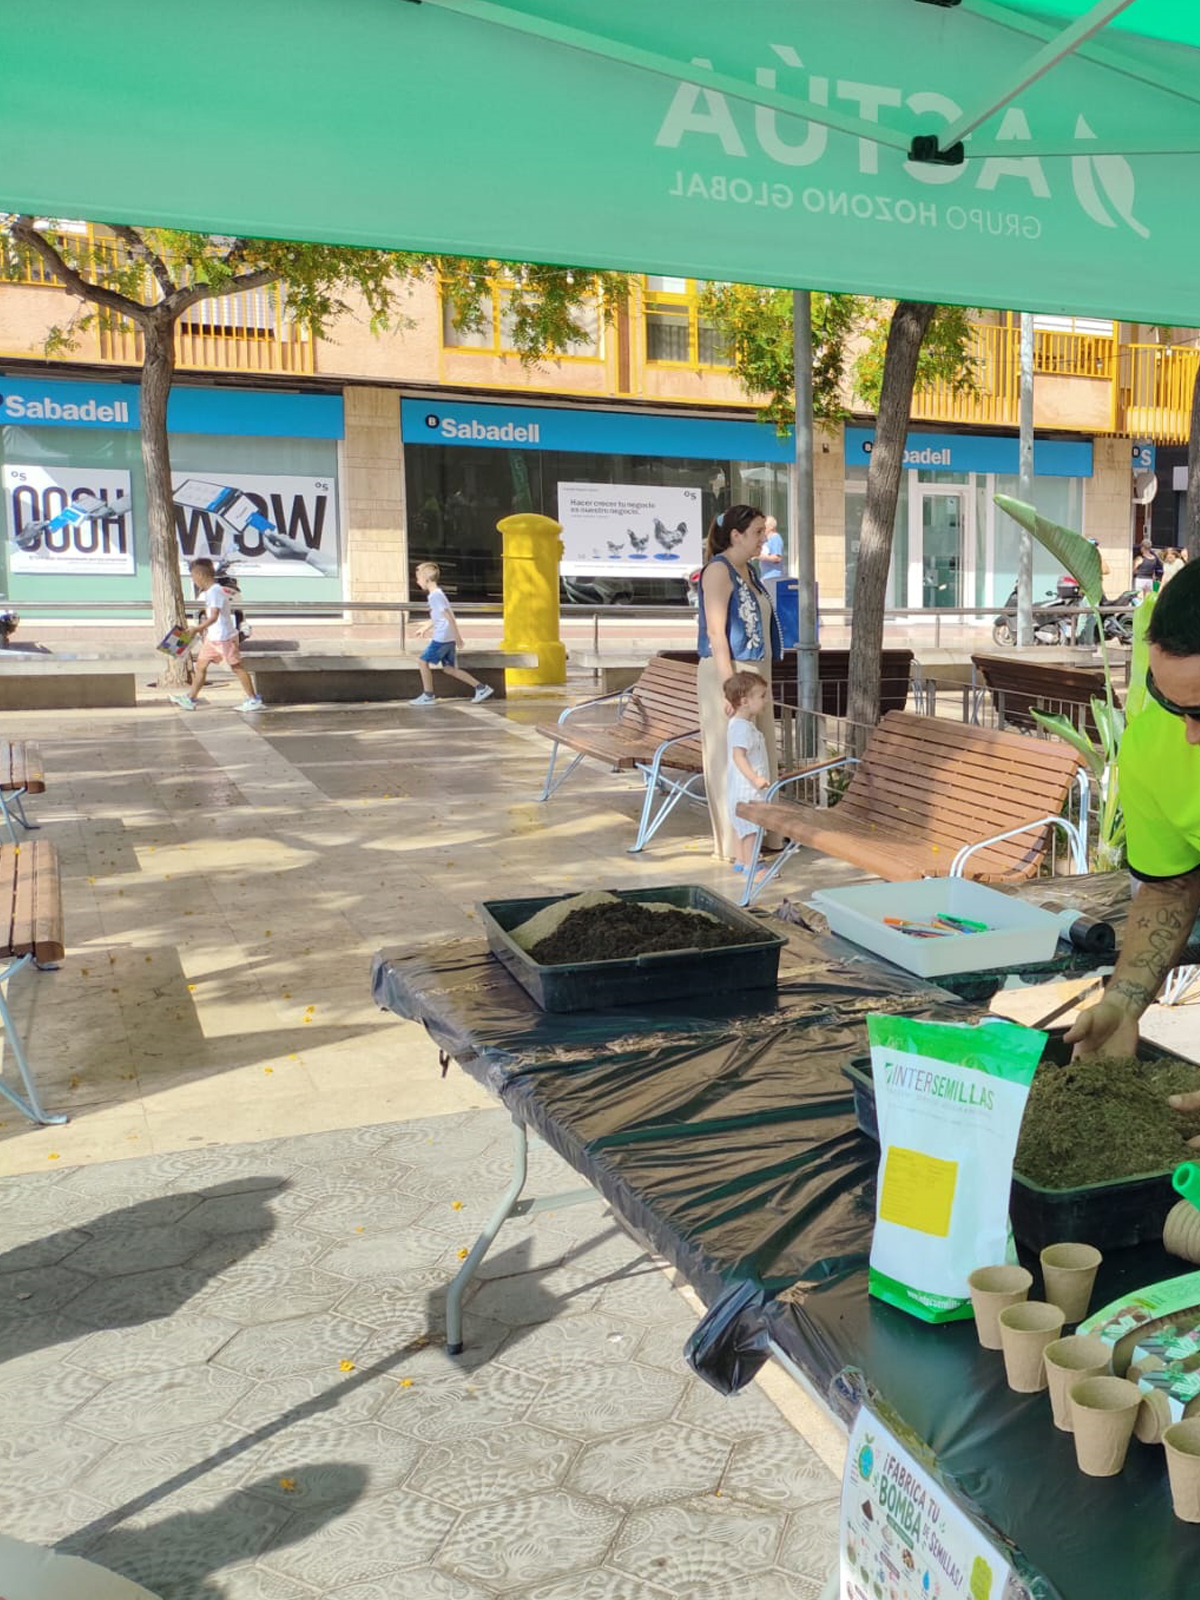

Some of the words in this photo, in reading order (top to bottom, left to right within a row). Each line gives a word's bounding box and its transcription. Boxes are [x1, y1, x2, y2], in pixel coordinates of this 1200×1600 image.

[5, 395, 129, 423] Sabadell
[441, 418, 540, 443] Sabadell
[891, 1063, 995, 1111] INTERSEMILLAS
[878, 1475, 923, 1544] BOMBA
[927, 1498, 941, 1524] TU
[929, 1534, 964, 1591] SEMILLAS!
